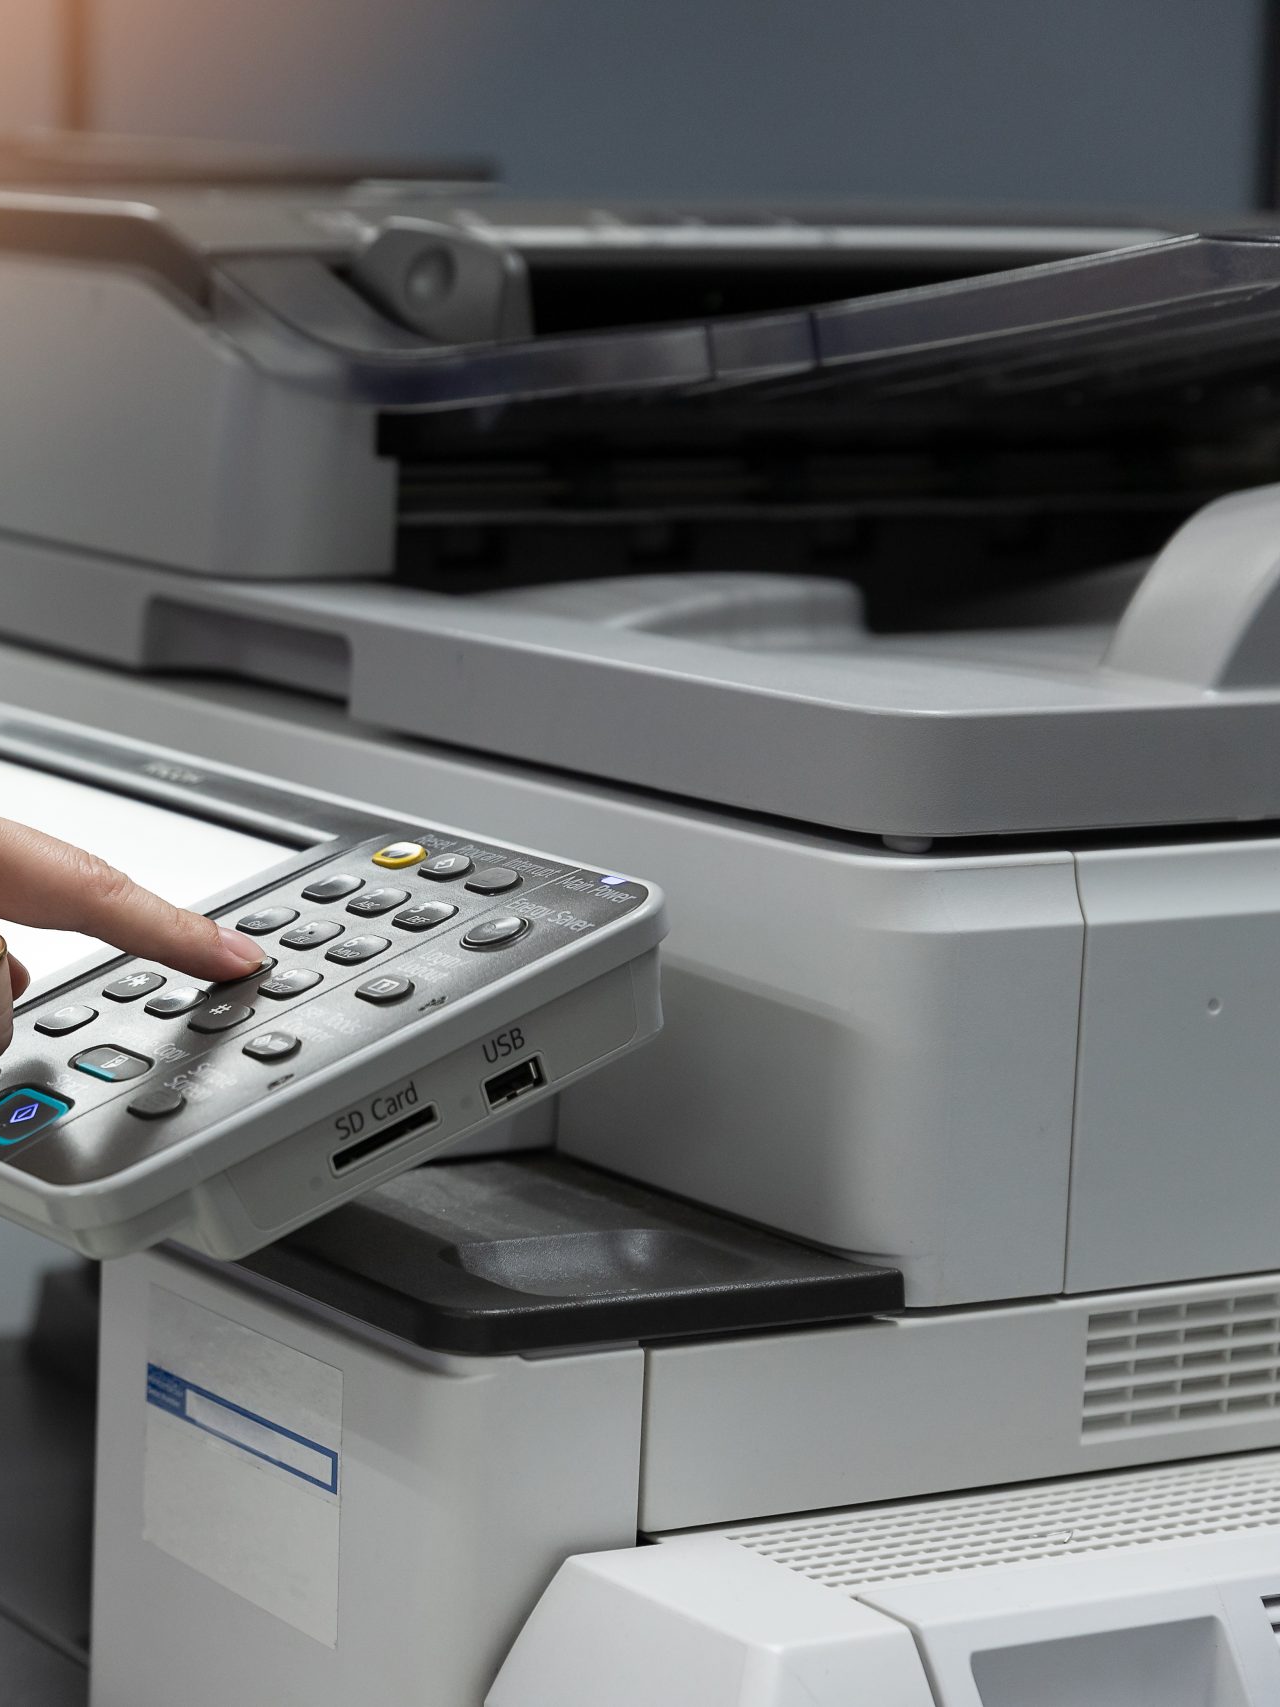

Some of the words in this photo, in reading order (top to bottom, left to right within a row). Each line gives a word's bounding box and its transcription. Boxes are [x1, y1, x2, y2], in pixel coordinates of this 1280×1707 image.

[414, 833, 458, 850] Reset
[501, 857, 563, 880] Interrupt
[555, 875, 593, 894] Main
[590, 883, 638, 905] Power
[504, 897, 553, 920] Energy
[548, 910, 596, 933] Saver
[153, 1042, 190, 1064] Copy
[482, 1027, 525, 1064] USB
[334, 1110, 365, 1141] SD
[371, 1080, 419, 1121] Card
